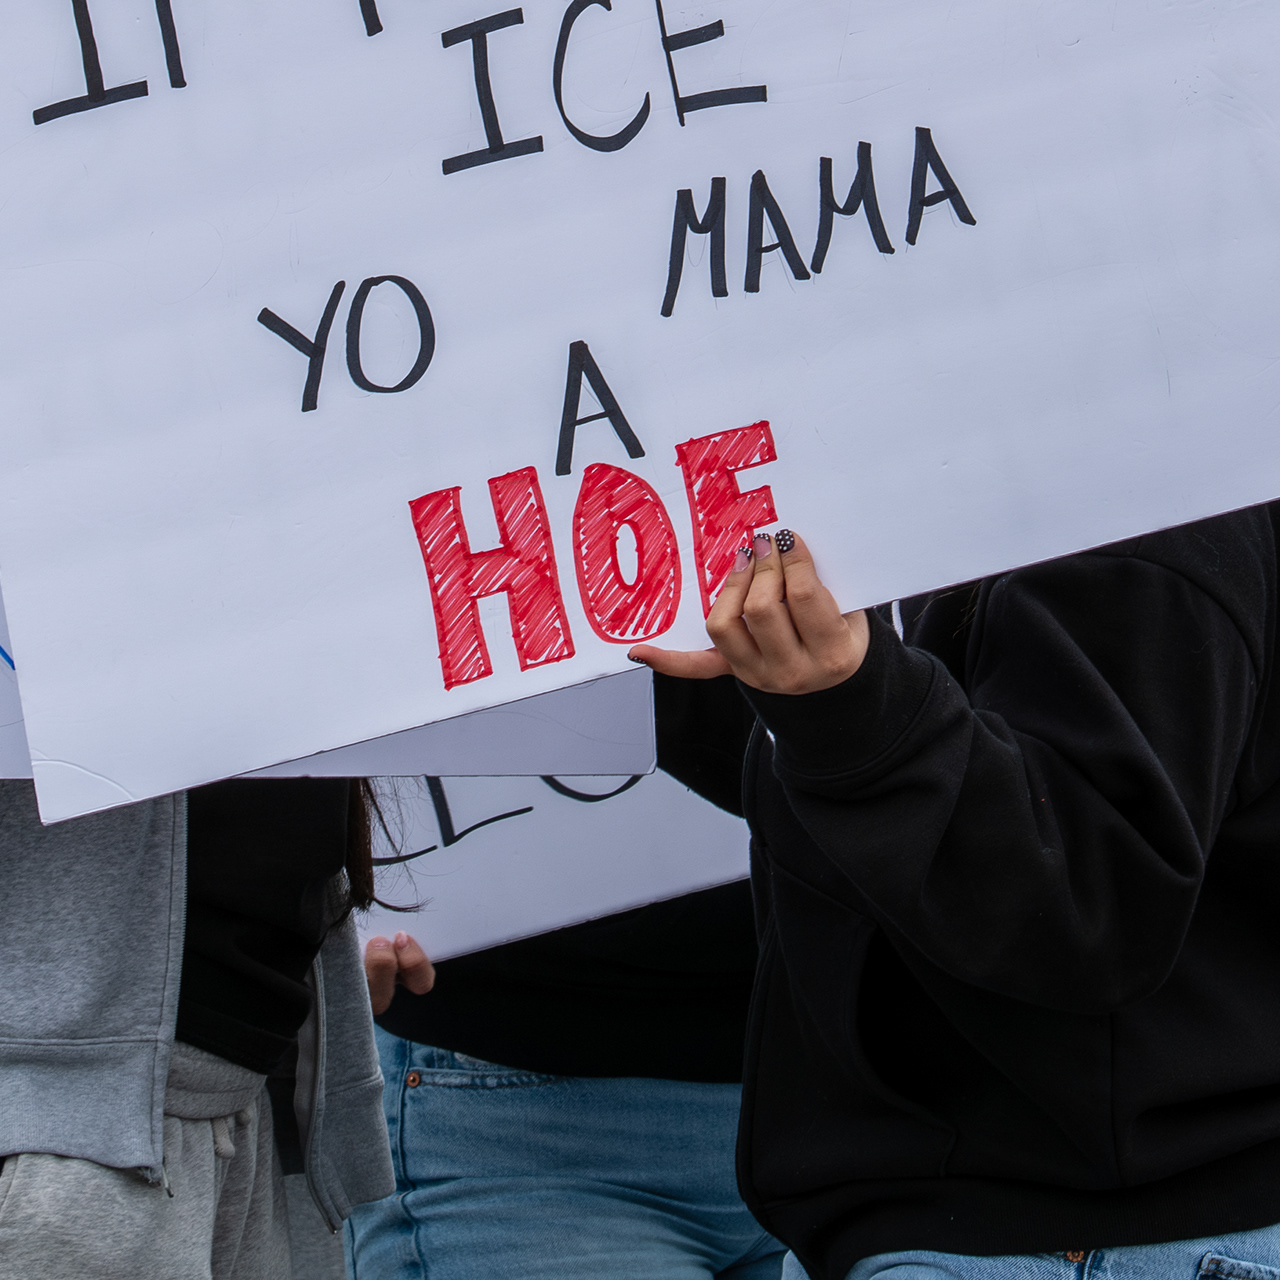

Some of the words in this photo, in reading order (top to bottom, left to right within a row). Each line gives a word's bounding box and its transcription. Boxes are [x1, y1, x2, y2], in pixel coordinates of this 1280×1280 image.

[257, 274, 436, 413] YO
[660, 126, 977, 318] MAMA
[555, 340, 646, 477] A
[407, 420, 779, 692] HOE
